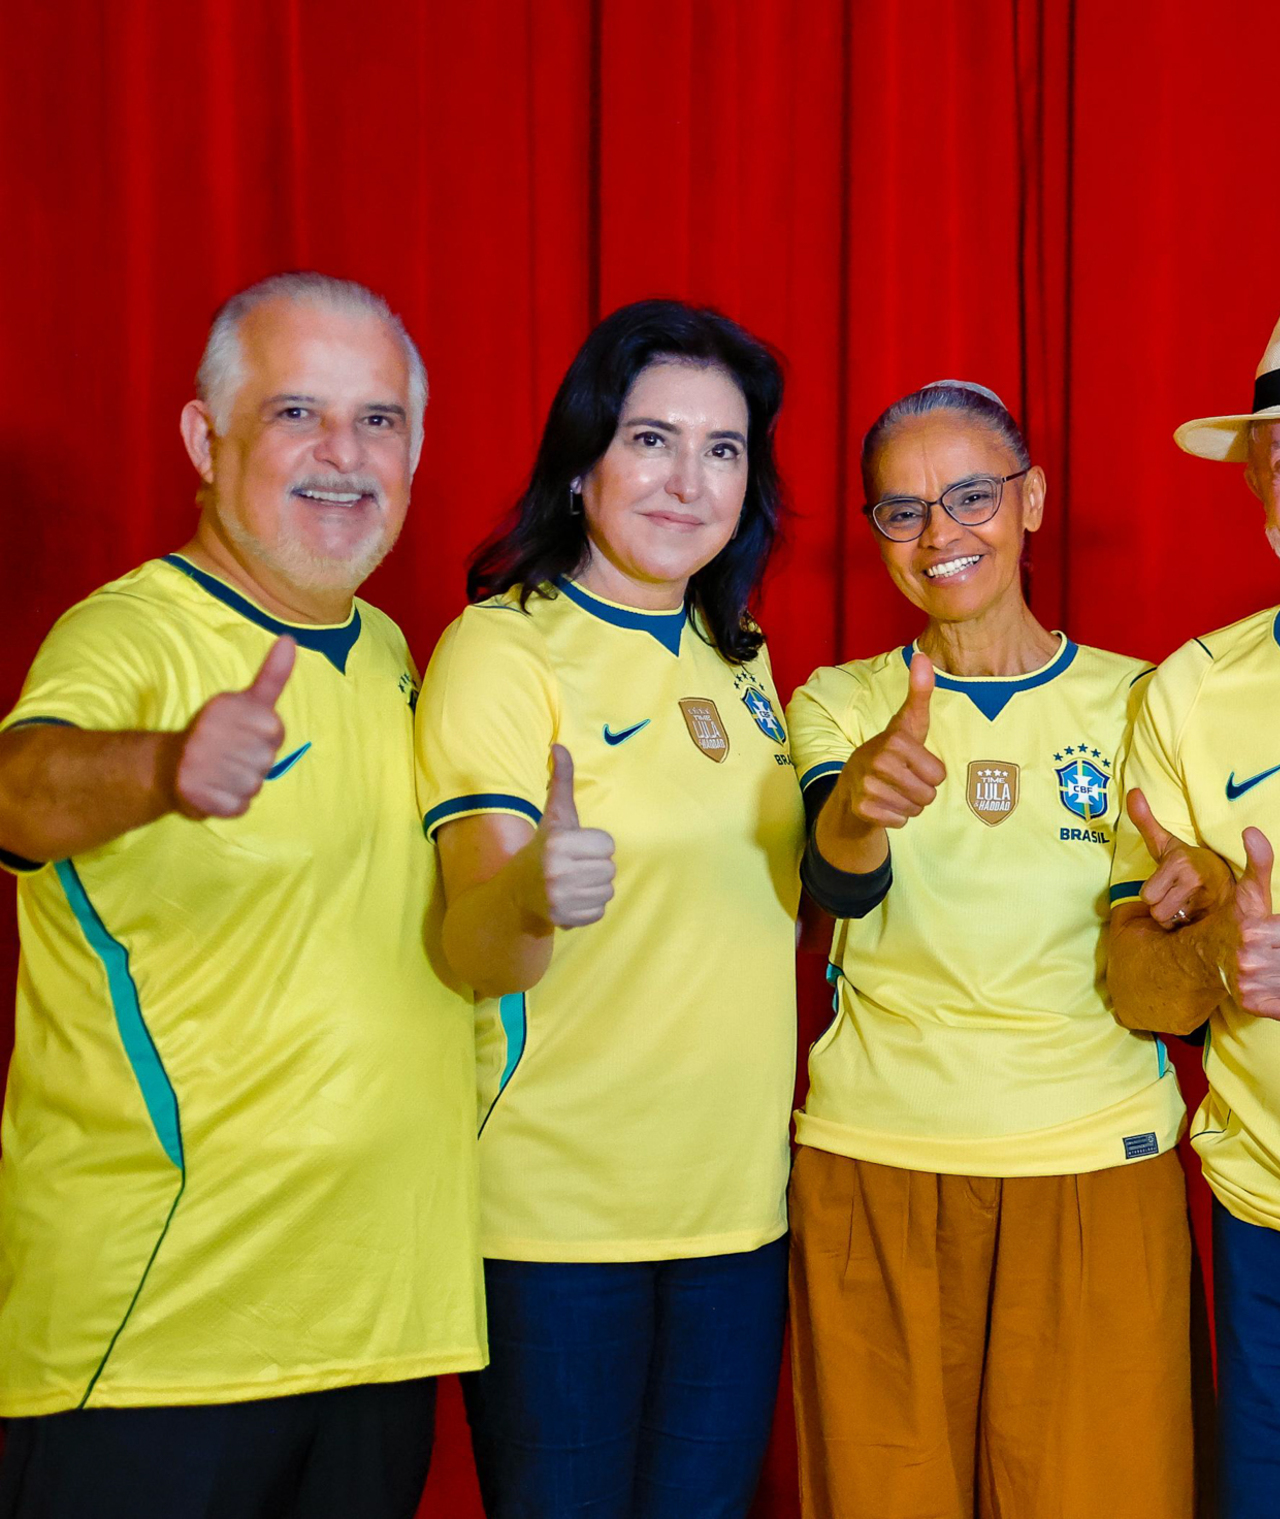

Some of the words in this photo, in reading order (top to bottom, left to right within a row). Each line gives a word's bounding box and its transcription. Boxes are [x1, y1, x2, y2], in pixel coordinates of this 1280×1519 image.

[692, 721, 721, 739] LULA
[774, 754, 792, 765] BRA
[976, 782, 1011, 800] LULA
[1073, 785, 1093, 794] CBF
[1060, 827, 1110, 844] BRASIL
